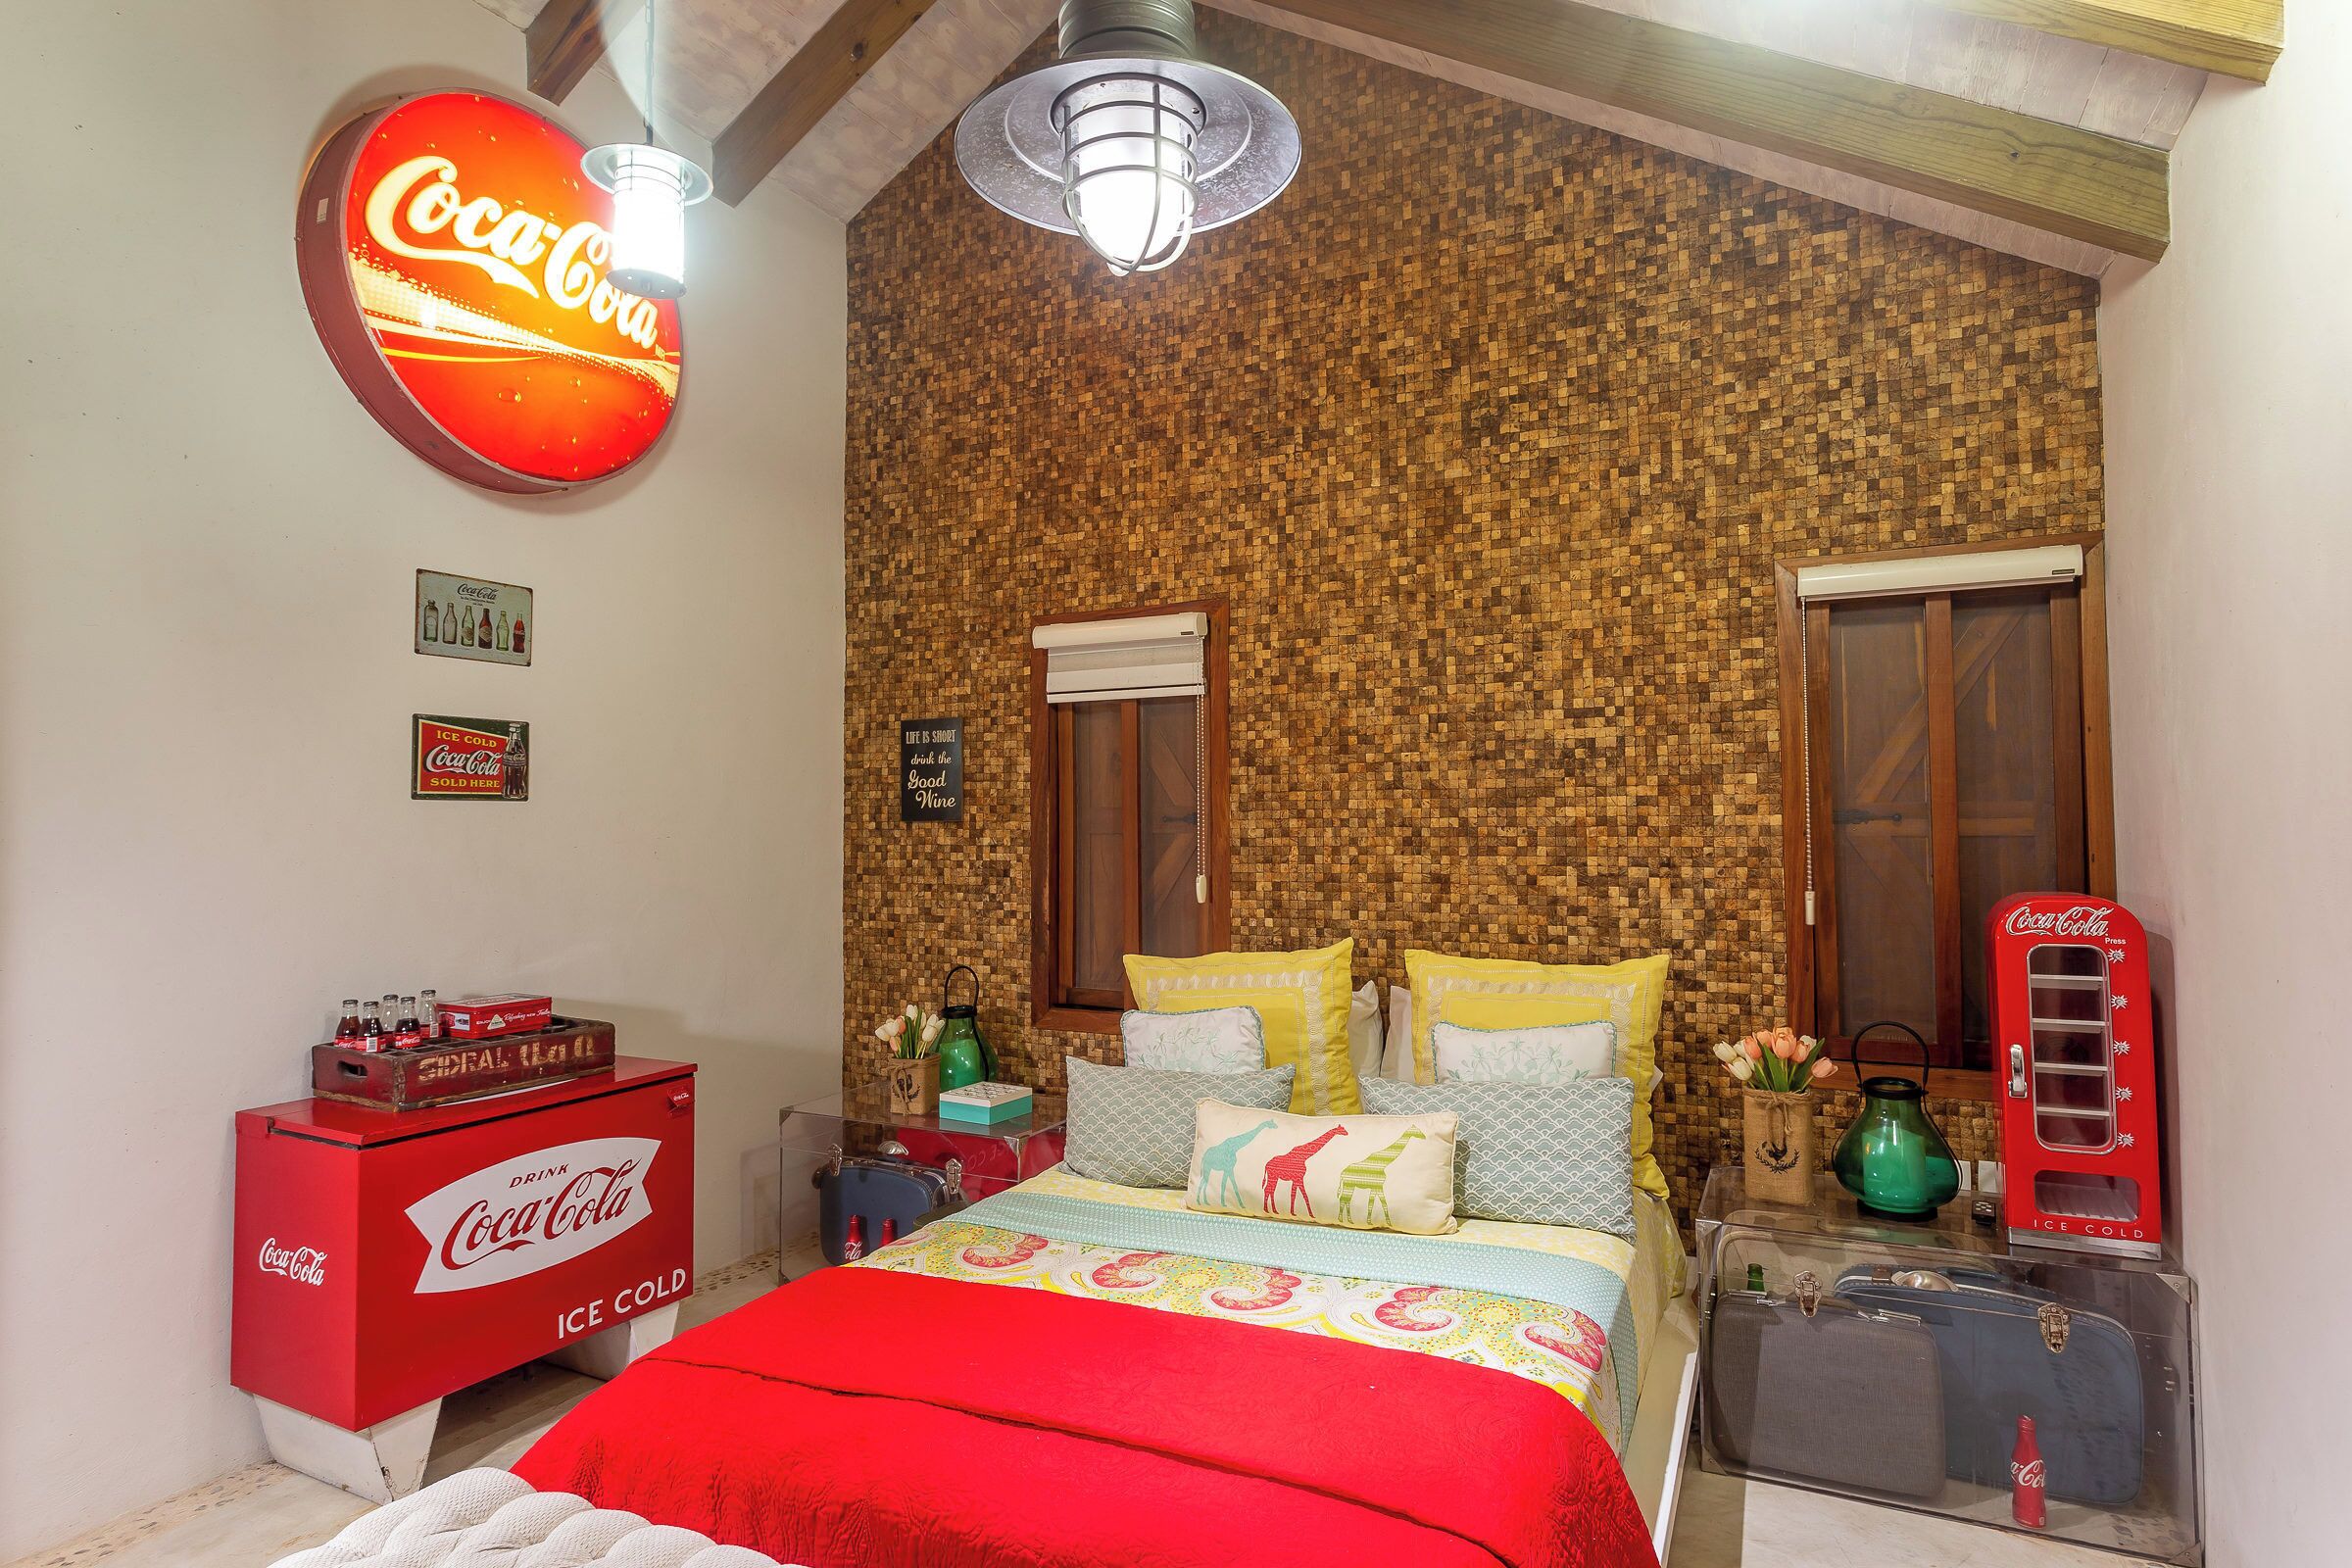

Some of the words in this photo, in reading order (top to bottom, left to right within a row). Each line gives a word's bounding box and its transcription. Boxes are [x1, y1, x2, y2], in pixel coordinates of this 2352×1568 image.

[436, 730, 460, 742] ICE
[464, 735, 498, 748] COLD
[906, 731, 920, 744] LIFE
[922, 731, 930, 744] IS
[932, 729, 956, 743] SHORT
[425, 744, 503, 776] Coca-Cola
[910, 751, 935, 764] drink
[938, 751, 952, 764] the
[429, 778, 467, 788] SOLD
[469, 779, 501, 789] HERE
[907, 769, 947, 790] Good
[915, 789, 956, 809] Wine
[2005, 906, 2115, 937] Coca-Cola
[509, 1163, 569, 1189] DRINK
[441, 1157, 643, 1271] Coca-Cola
[2034, 1218, 2068, 1231] ICE
[2084, 1224, 2143, 1239] COLD
[259, 1237, 328, 1287] Coca-Cola
[558, 1298, 604, 1340] ICE
[613, 1268, 686, 1314] COLD
